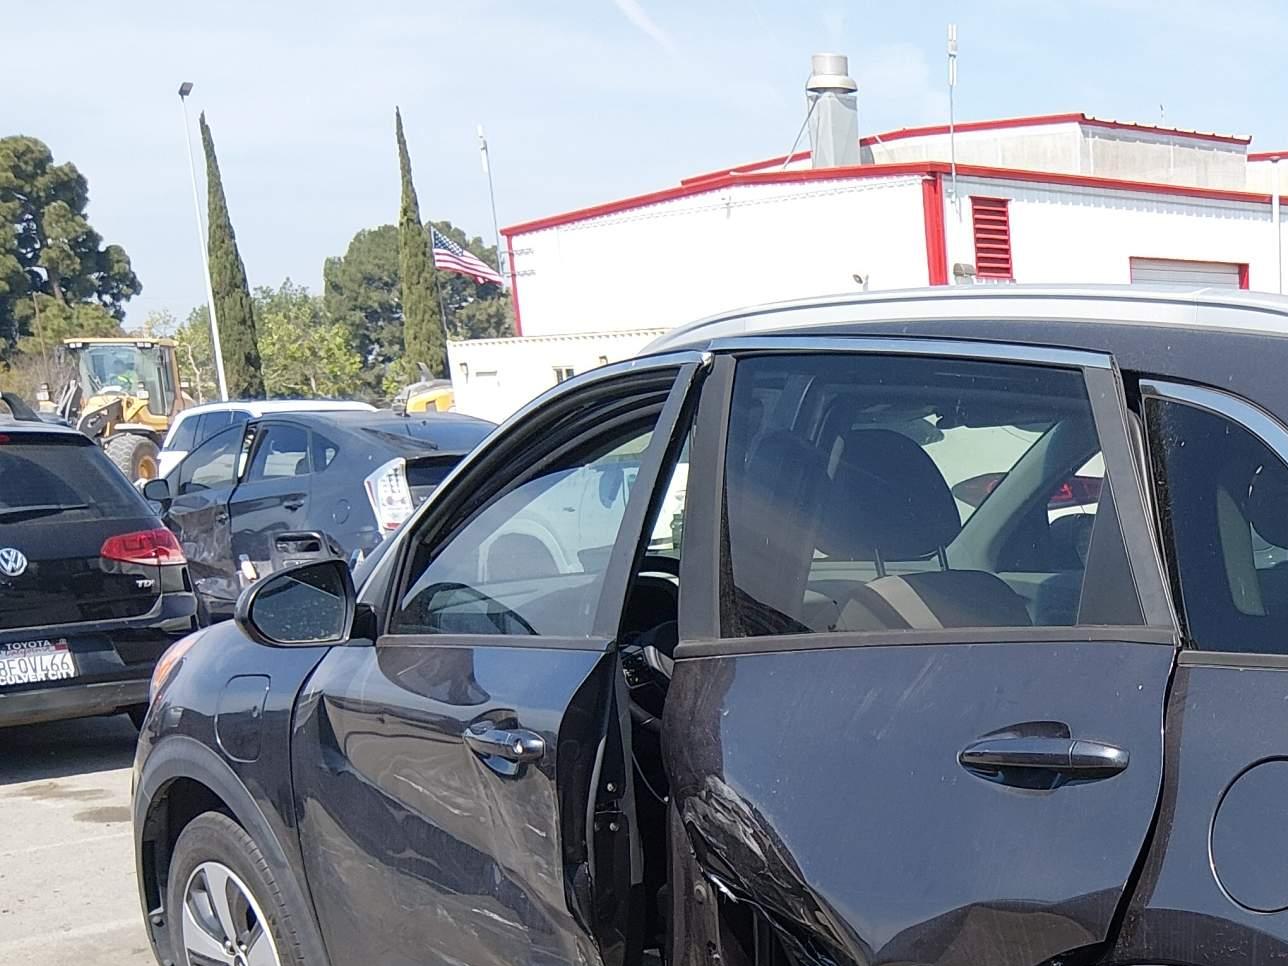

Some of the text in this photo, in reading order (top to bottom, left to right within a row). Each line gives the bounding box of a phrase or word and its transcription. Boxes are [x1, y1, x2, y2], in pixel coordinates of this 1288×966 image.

[5, 640, 51, 650] TOYOTA
[0, 669, 75, 686] CULVER CITY
